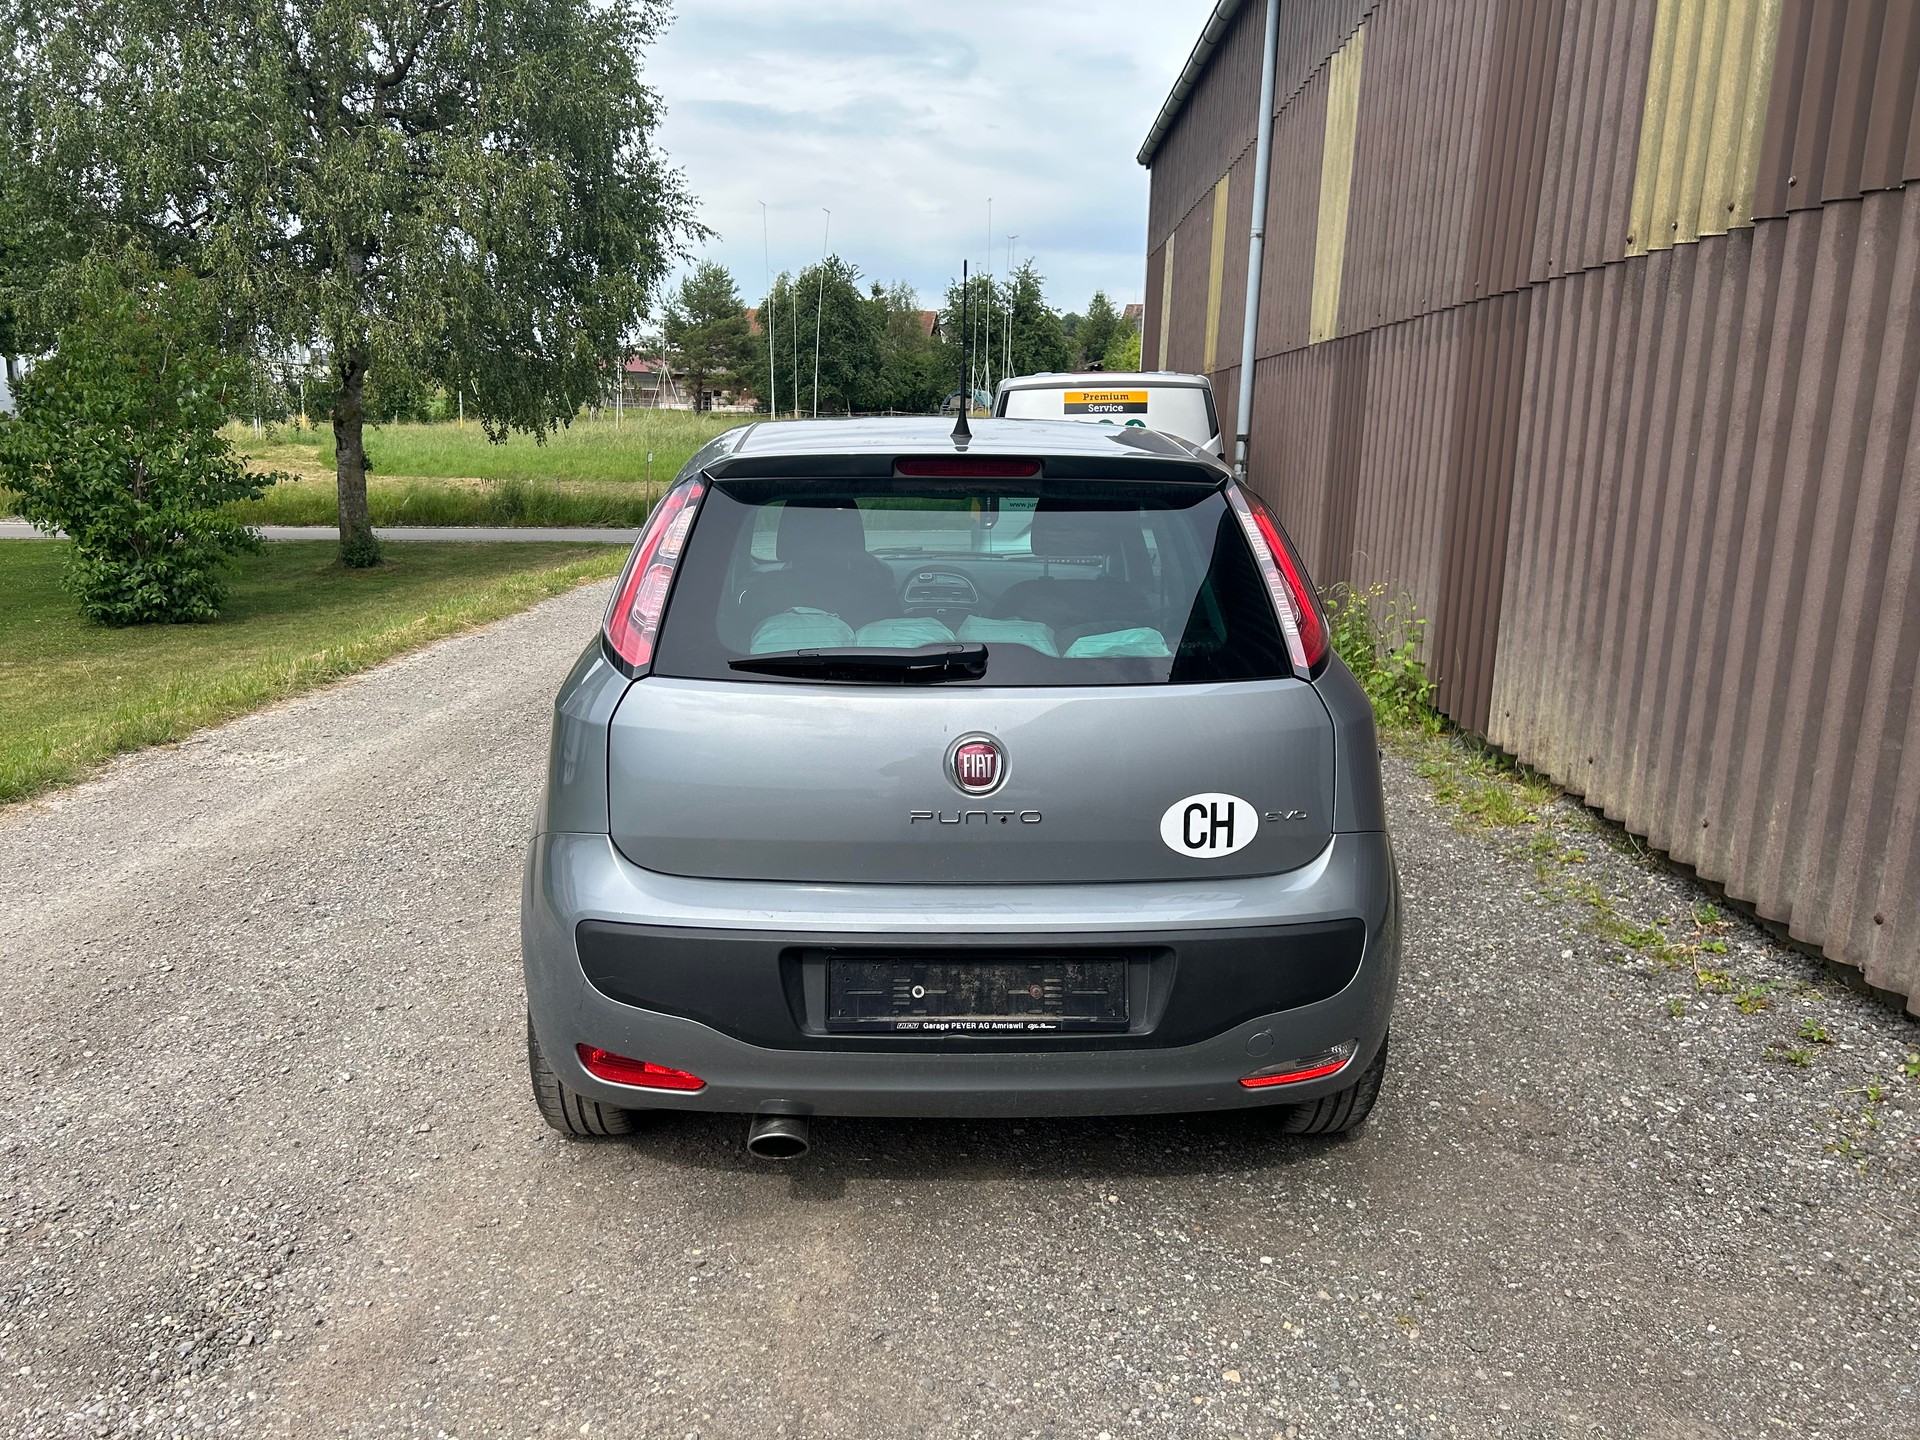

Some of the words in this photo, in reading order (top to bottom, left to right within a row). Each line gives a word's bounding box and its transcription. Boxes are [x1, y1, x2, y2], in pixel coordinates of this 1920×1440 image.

[1082, 391, 1129, 401] Premium
[1087, 403, 1124, 413] Service
[963, 753, 994, 778] FIAT
[910, 810, 1042, 824] PUNTO
[1264, 810, 1308, 822] EVO
[1183, 802, 1235, 849] CH
[922, 1022, 950, 1031] Garage
[951, 1022, 977, 1030] PEYER
[978, 1022, 990, 1030] AG
[991, 1022, 1024, 1030] Amriswil
